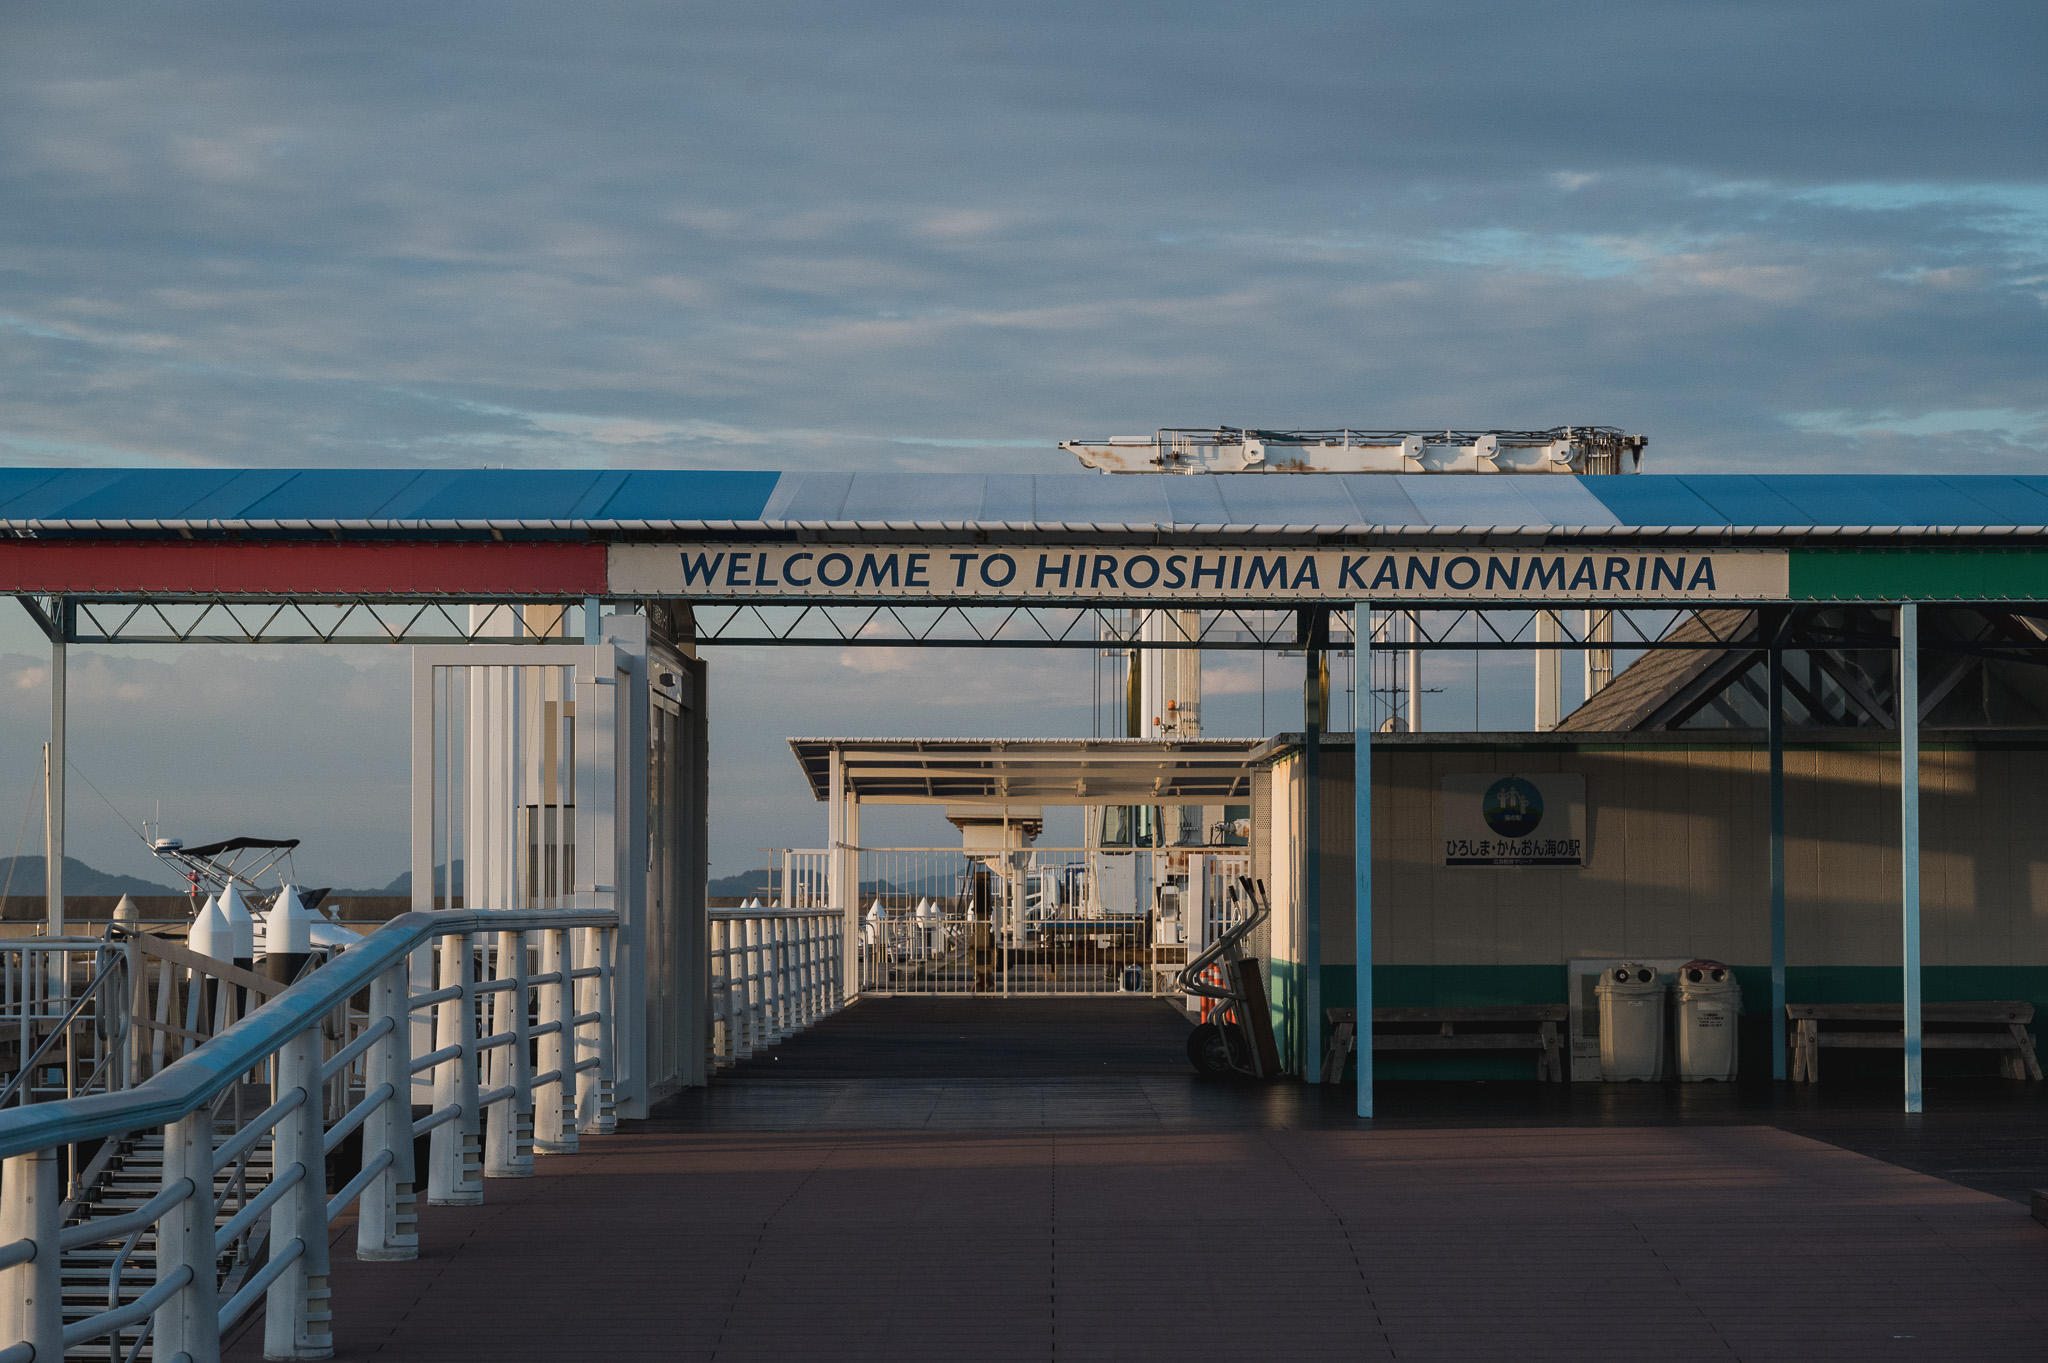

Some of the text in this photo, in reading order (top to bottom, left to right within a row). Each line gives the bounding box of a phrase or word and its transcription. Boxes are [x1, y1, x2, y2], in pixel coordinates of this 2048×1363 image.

[680, 552, 1717, 591] WELCOME TO HIROSHIMA KANONMARINA
[1446, 839, 1581, 857] ひろしま・かんおん海の駅
